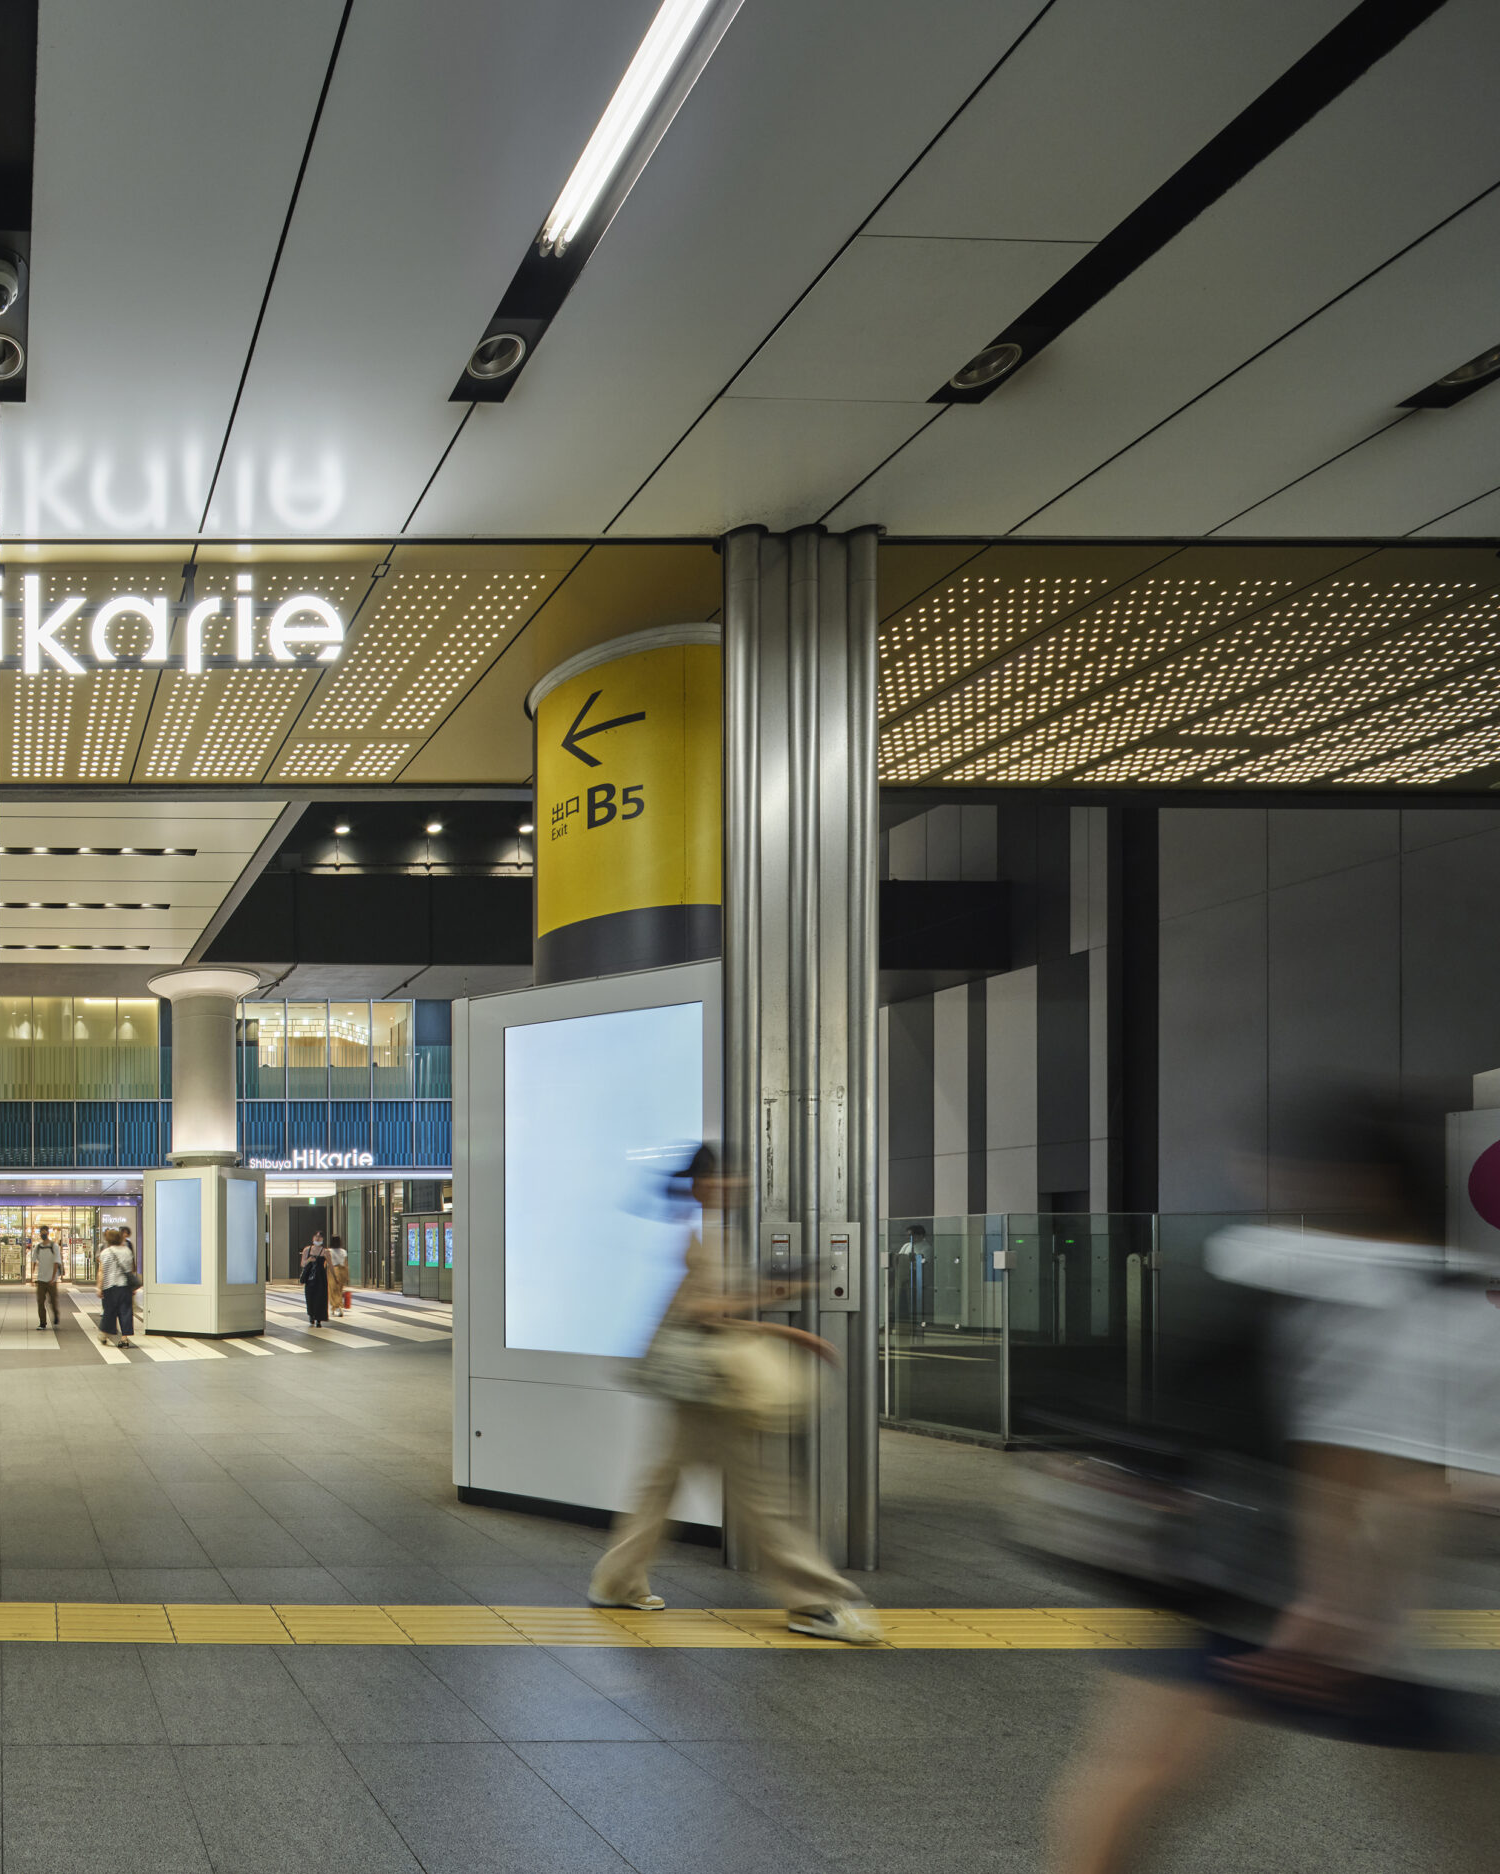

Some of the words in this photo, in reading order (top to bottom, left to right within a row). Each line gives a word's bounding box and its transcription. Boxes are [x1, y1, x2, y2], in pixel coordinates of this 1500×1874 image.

[551, 795, 580, 826] 出口
[586, 782, 645, 830] B5
[551, 823, 568, 841] Exit
[249, 1158, 292, 1170] Shibuya
[292, 1149, 374, 1169] Hikarie
